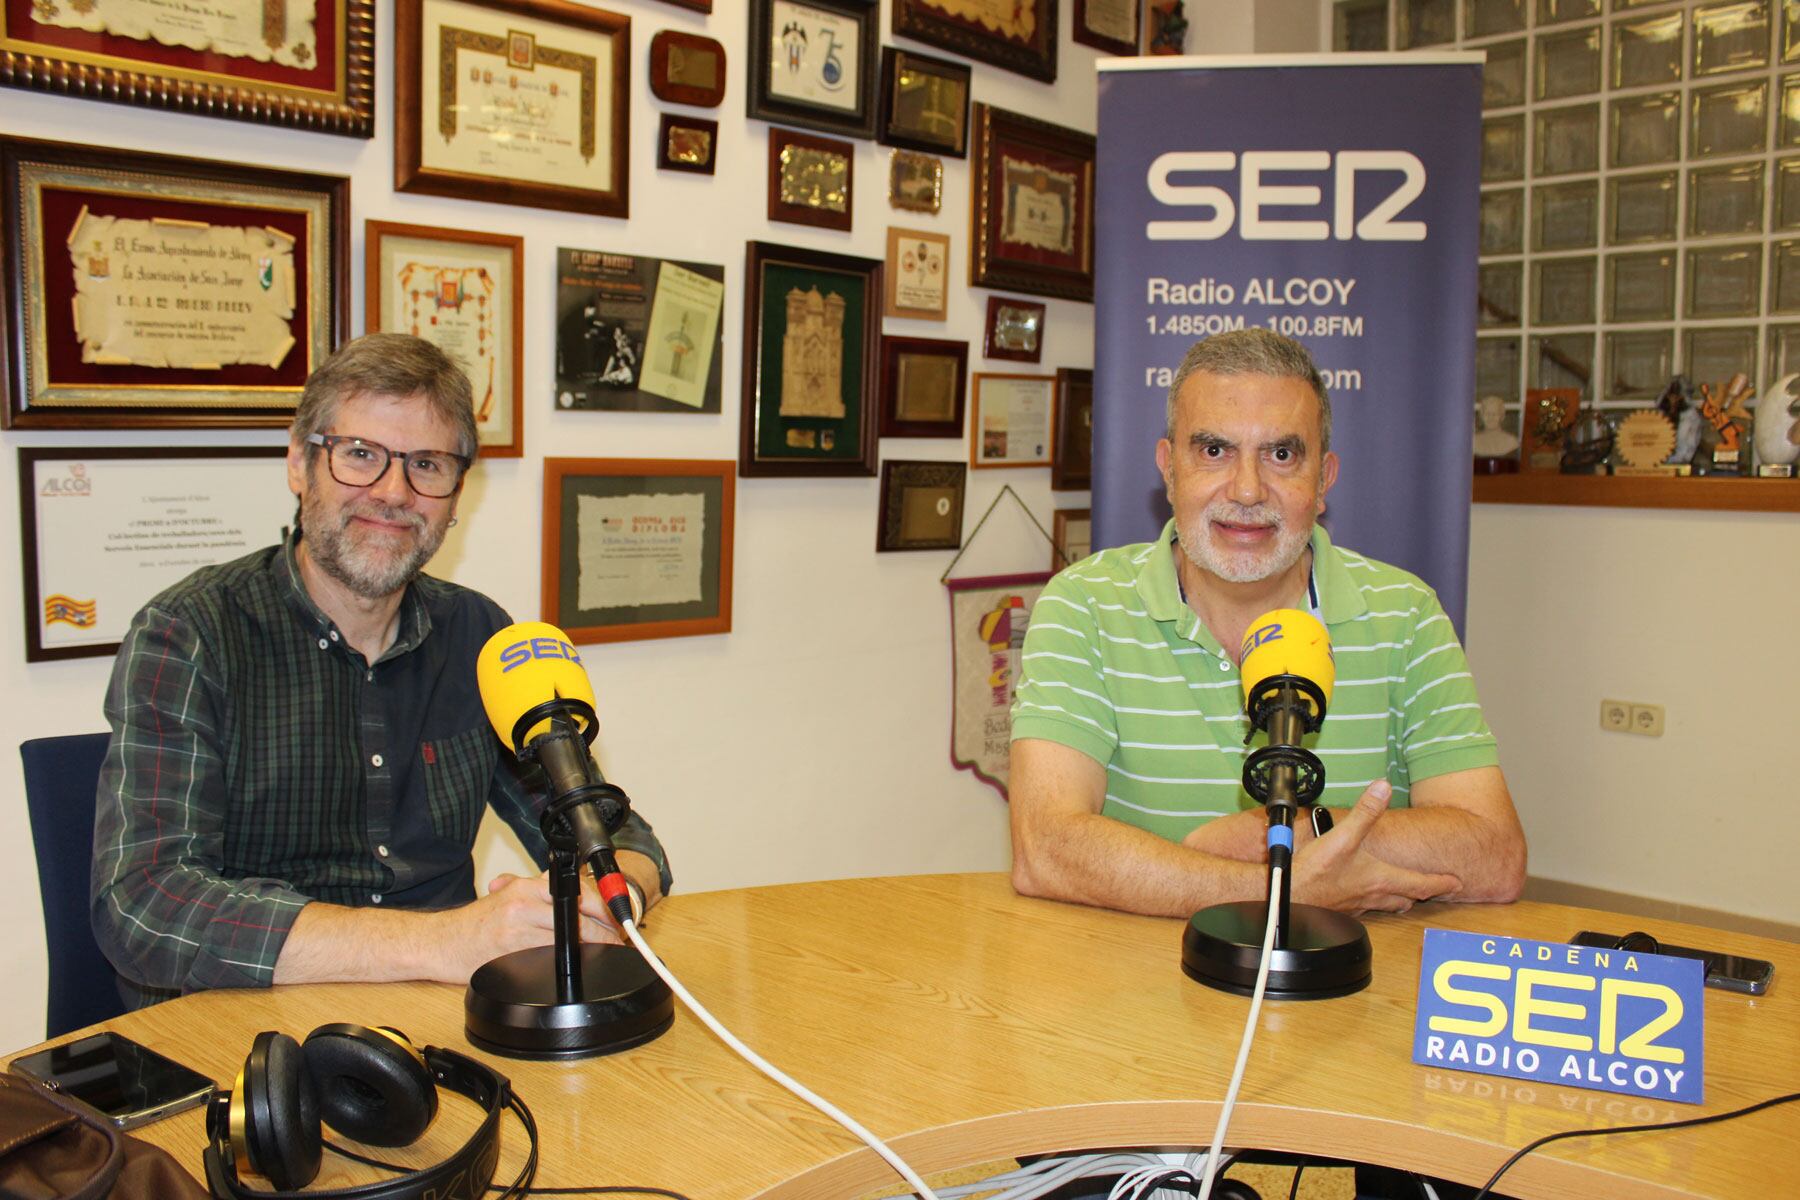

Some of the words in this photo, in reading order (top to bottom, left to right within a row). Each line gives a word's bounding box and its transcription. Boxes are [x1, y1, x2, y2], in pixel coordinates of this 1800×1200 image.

[1146, 150, 1427, 240] SER
[1147, 278, 1234, 305] Radio
[1242, 278, 1356, 305] ALCOY
[1268, 316, 1363, 336] 100.8FM
[1241, 624, 1283, 663] ER
[1482, 940, 1639, 972] CADENA
[1429, 960, 1685, 1065] SER
[1426, 1036, 1540, 1073] RADIO
[1560, 1055, 1684, 1093] ALCOY
